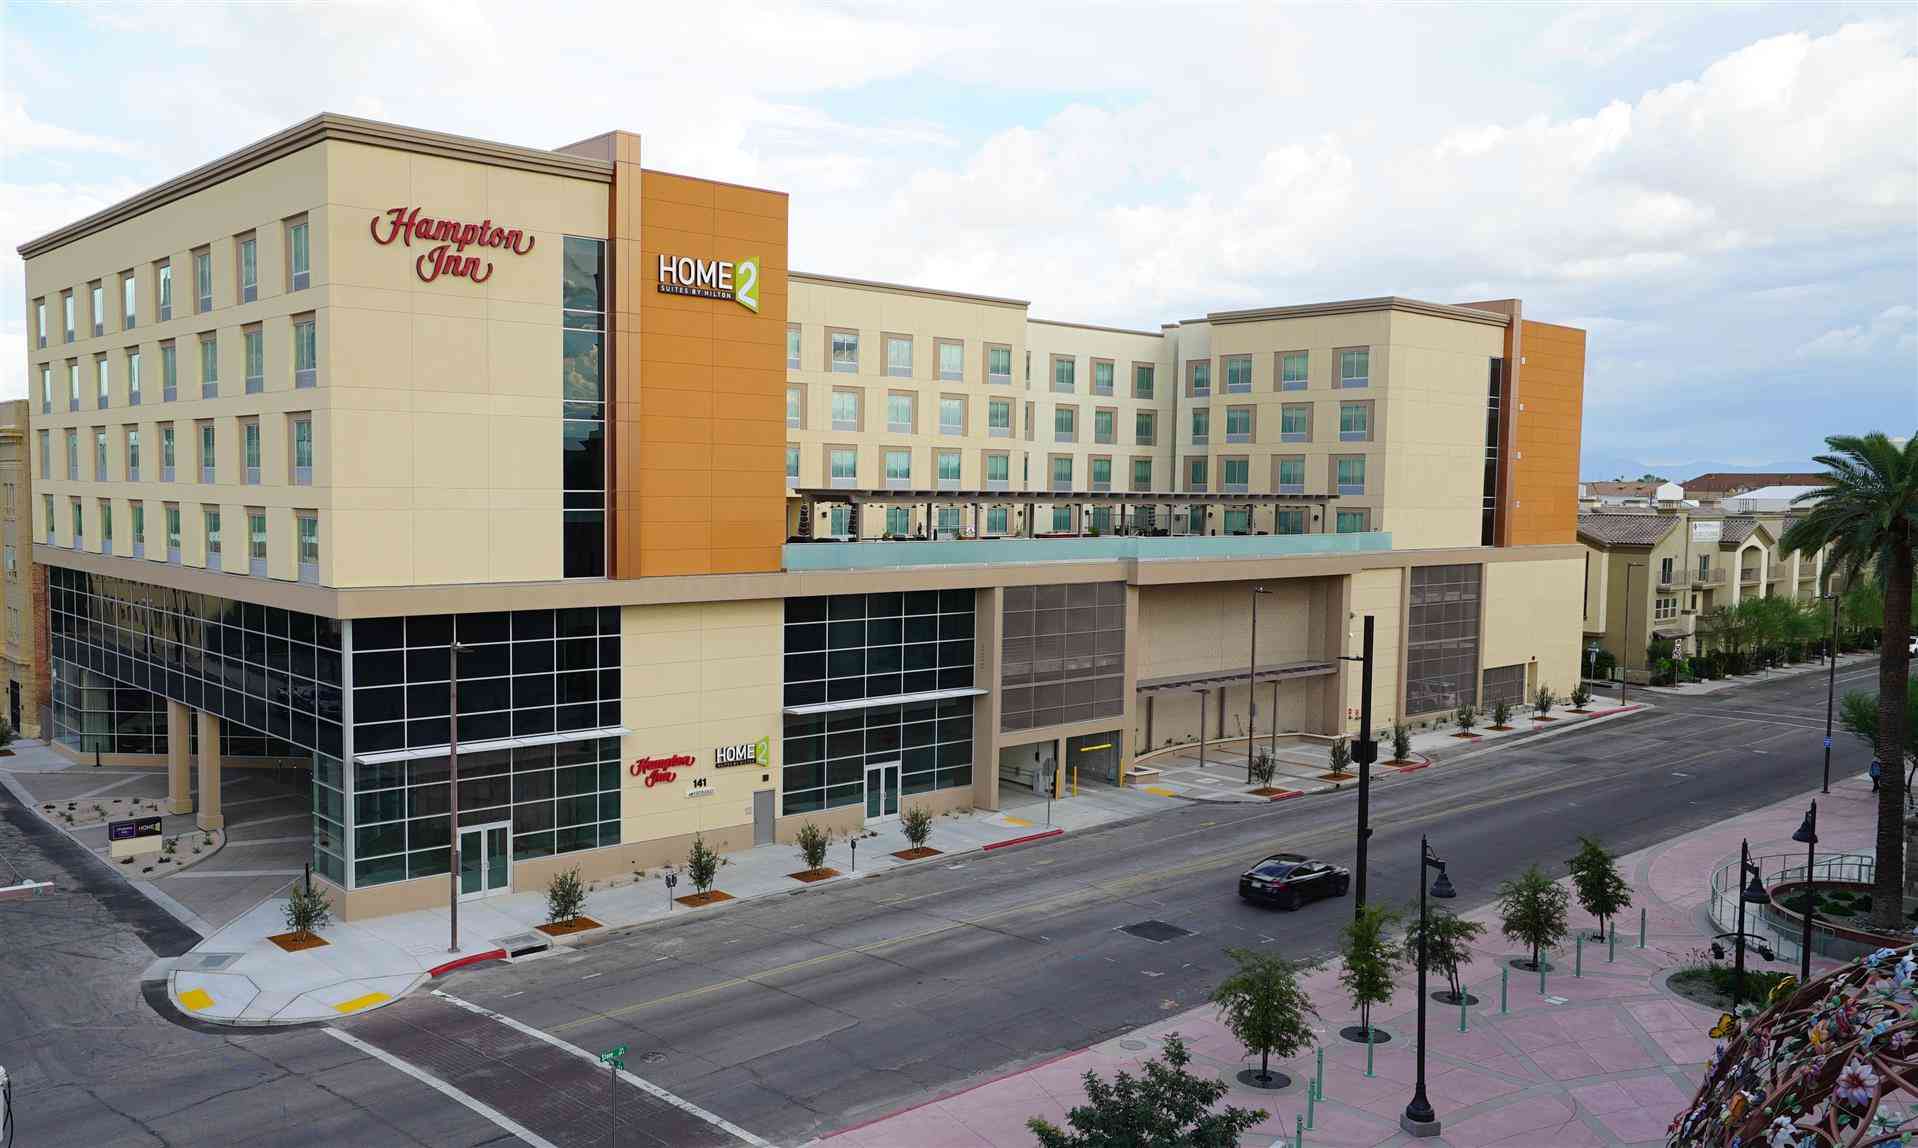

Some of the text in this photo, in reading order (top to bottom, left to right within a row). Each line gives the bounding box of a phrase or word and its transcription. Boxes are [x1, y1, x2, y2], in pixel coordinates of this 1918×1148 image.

[371, 207, 535, 255] Hampton
[416, 245, 493, 283] Inn
[658, 254, 733, 290] HOME
[660, 284, 732, 298] SUITES BY HILTON
[716, 744, 755, 763] HOME
[630, 754, 696, 776] Hampton
[645, 769, 676, 788] Inn
[693, 777, 706, 788] 141
